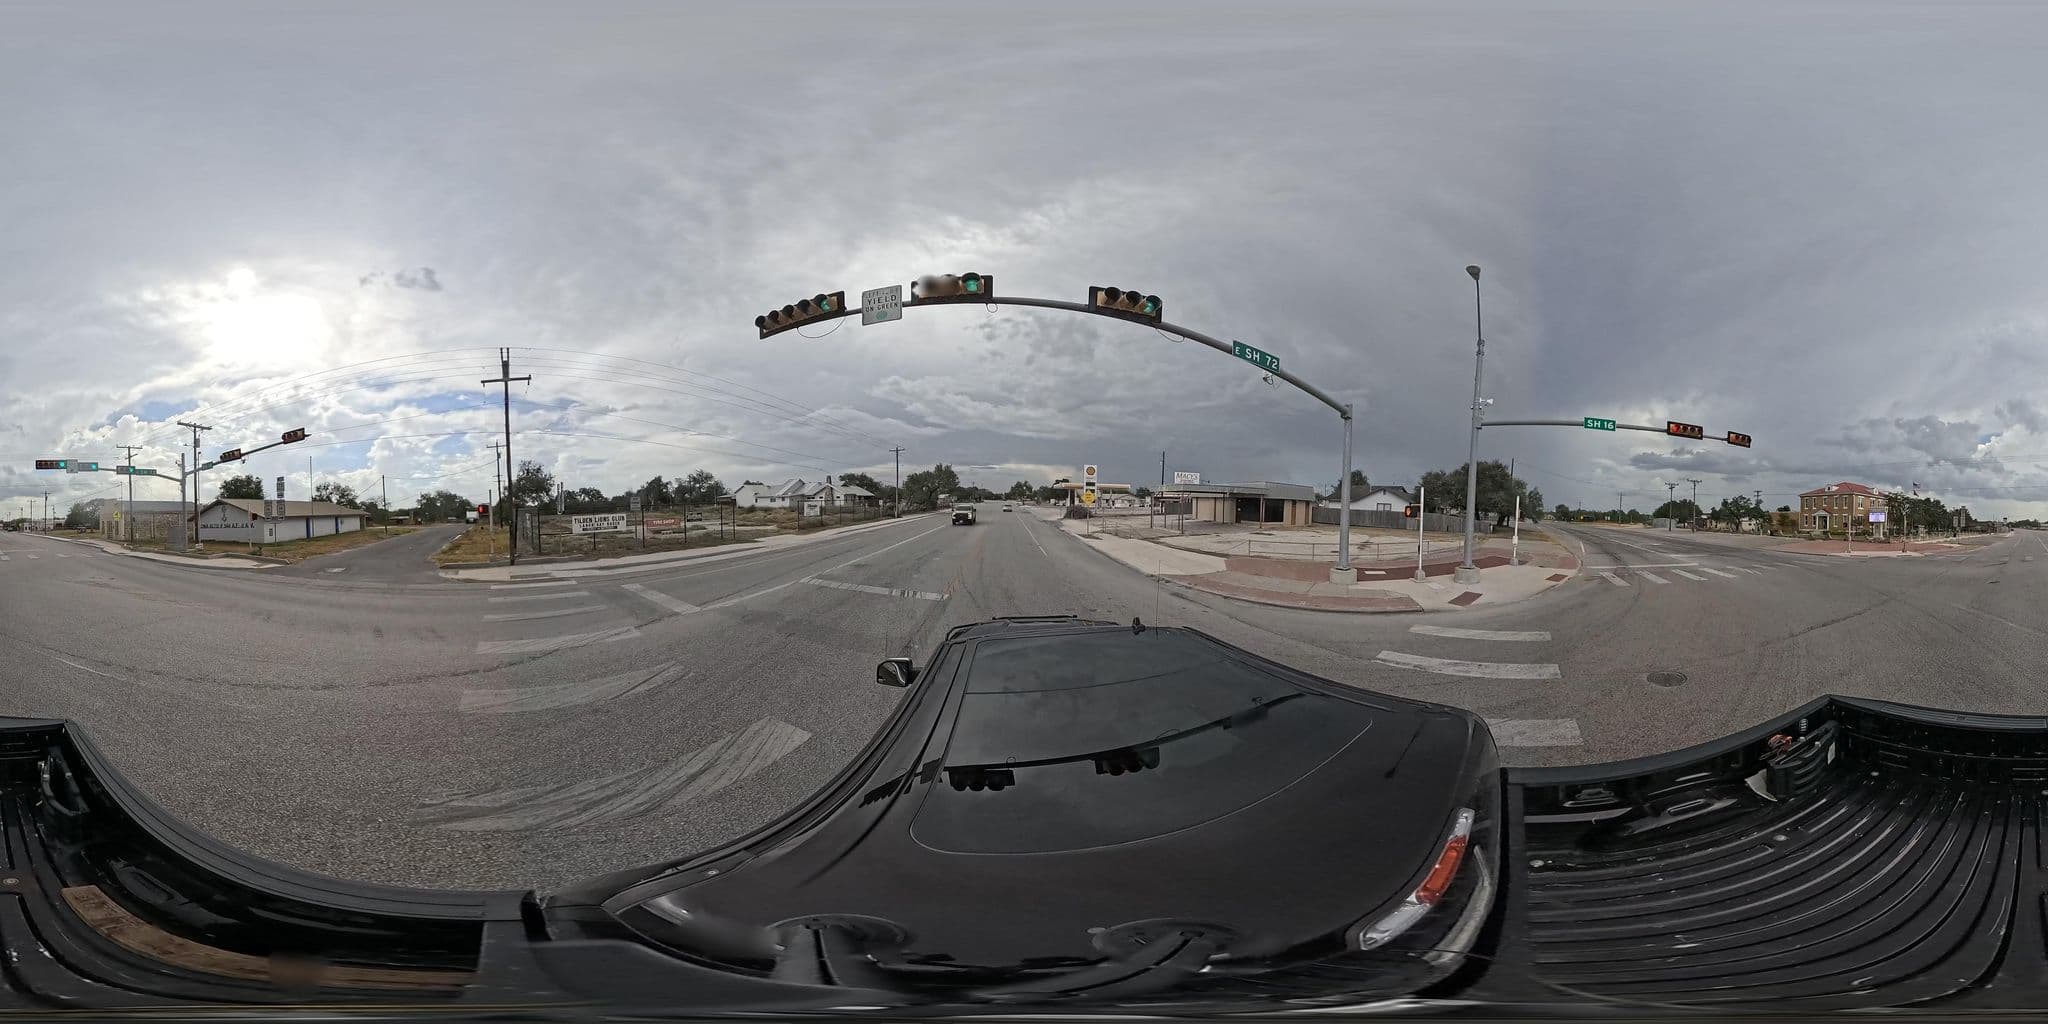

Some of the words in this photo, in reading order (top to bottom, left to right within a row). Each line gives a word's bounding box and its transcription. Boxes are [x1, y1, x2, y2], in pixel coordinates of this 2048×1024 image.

[867, 294, 896, 305] YIELD
[1235, 346, 1241, 355] E
[1245, 348, 1260, 362] SH
[1265, 355, 1278, 370] 72
[1587, 419, 1601, 428] SH
[1603, 421, 1614, 430] 16
